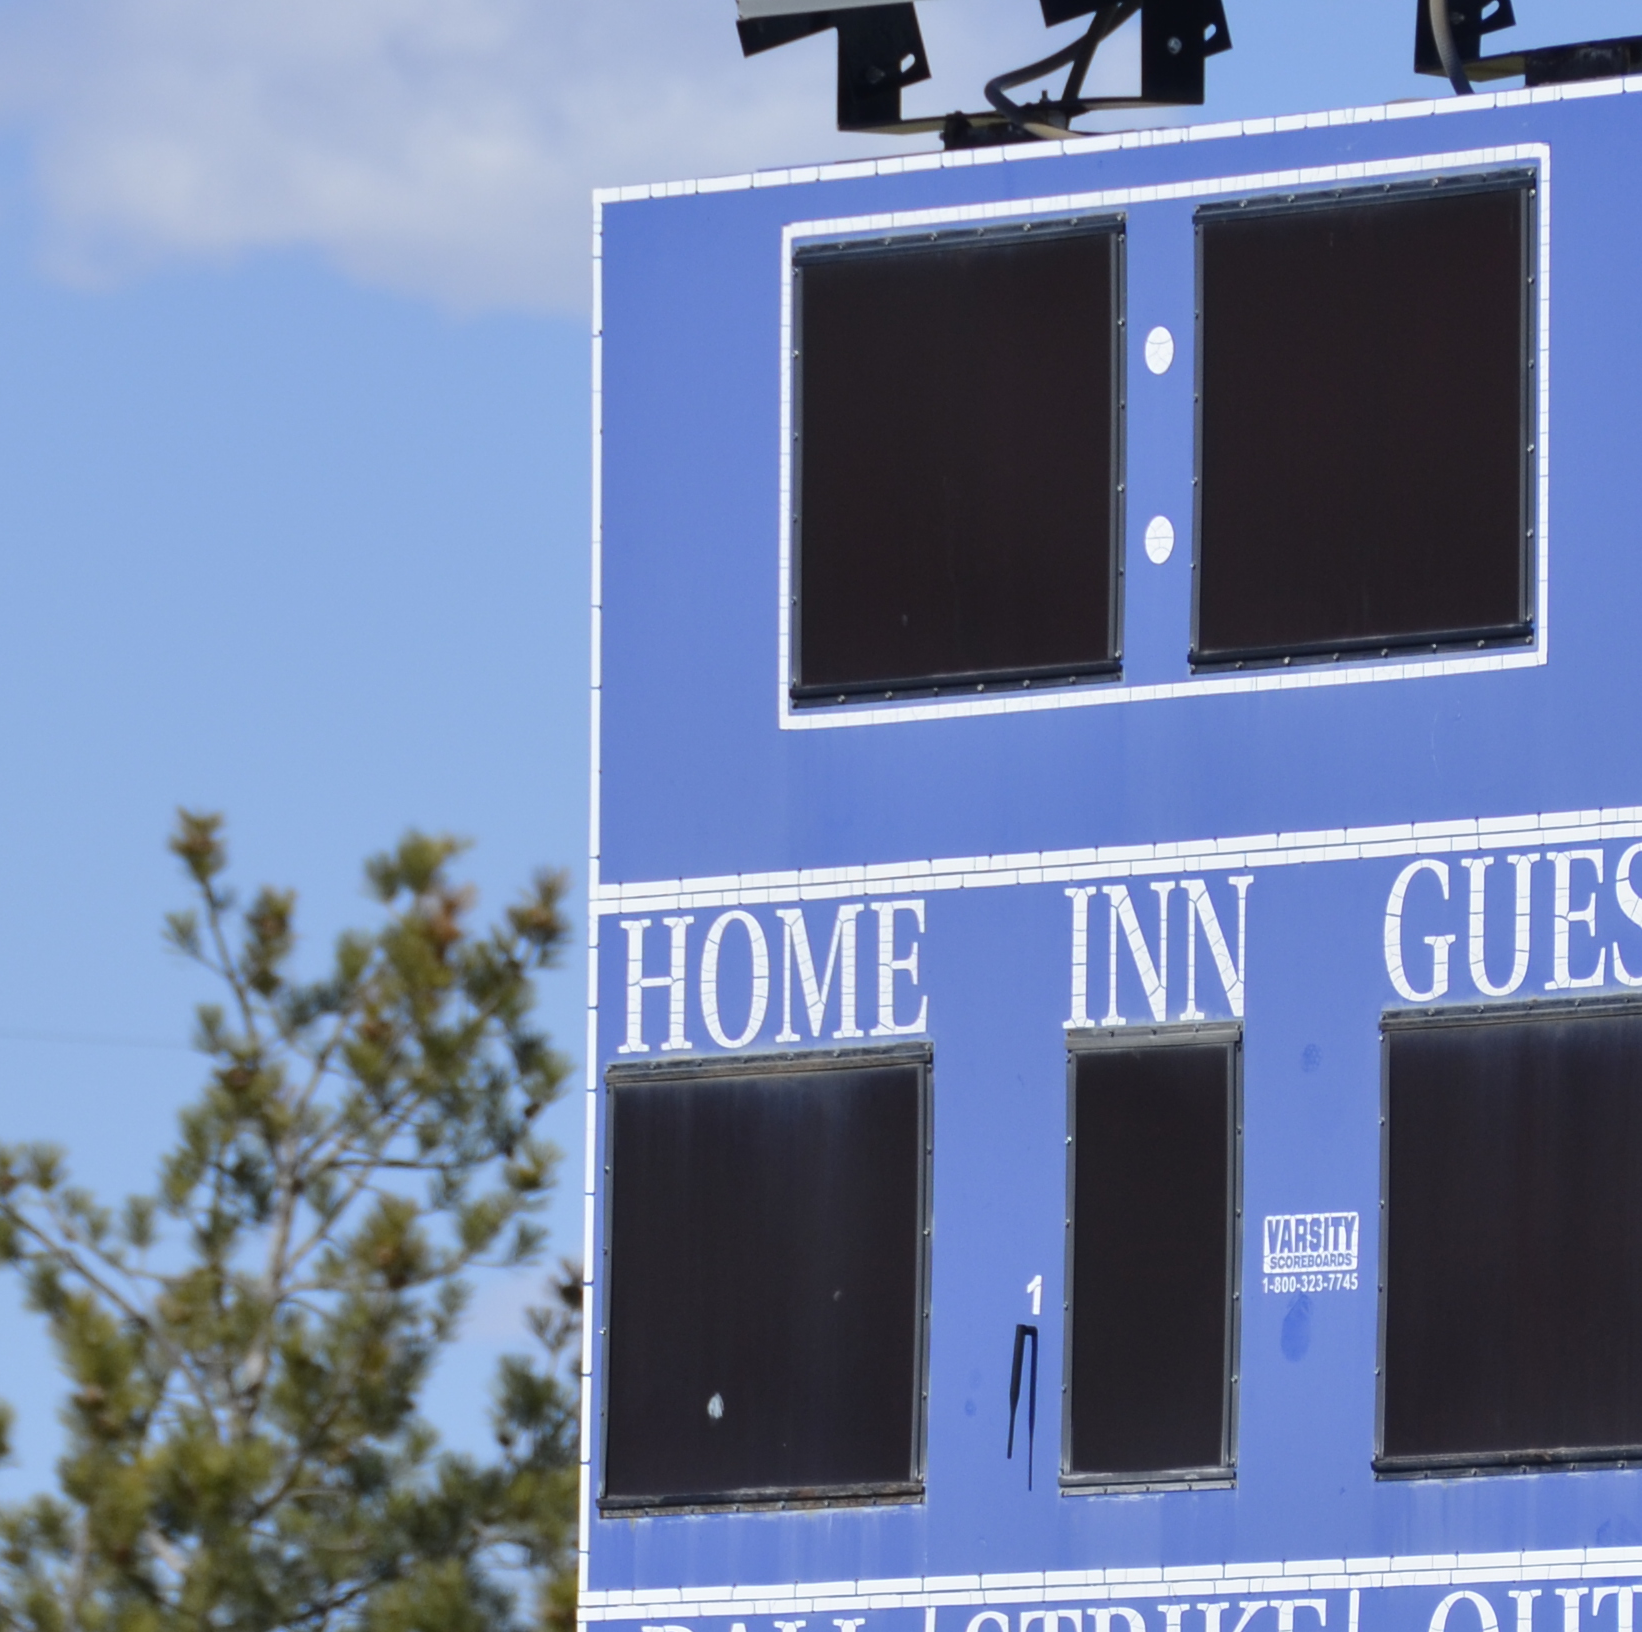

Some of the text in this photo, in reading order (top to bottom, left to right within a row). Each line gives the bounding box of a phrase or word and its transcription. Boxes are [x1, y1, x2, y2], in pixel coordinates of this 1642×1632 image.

[1063, 875, 1255, 1031] INN
[618, 898, 928, 1054] HOME
[1267, 1216, 1357, 1252] VARSITY
[1270, 1254, 1352, 1269] SCOREBOARDS
[1262, 1273, 1358, 1293] 1-800-323-7745
